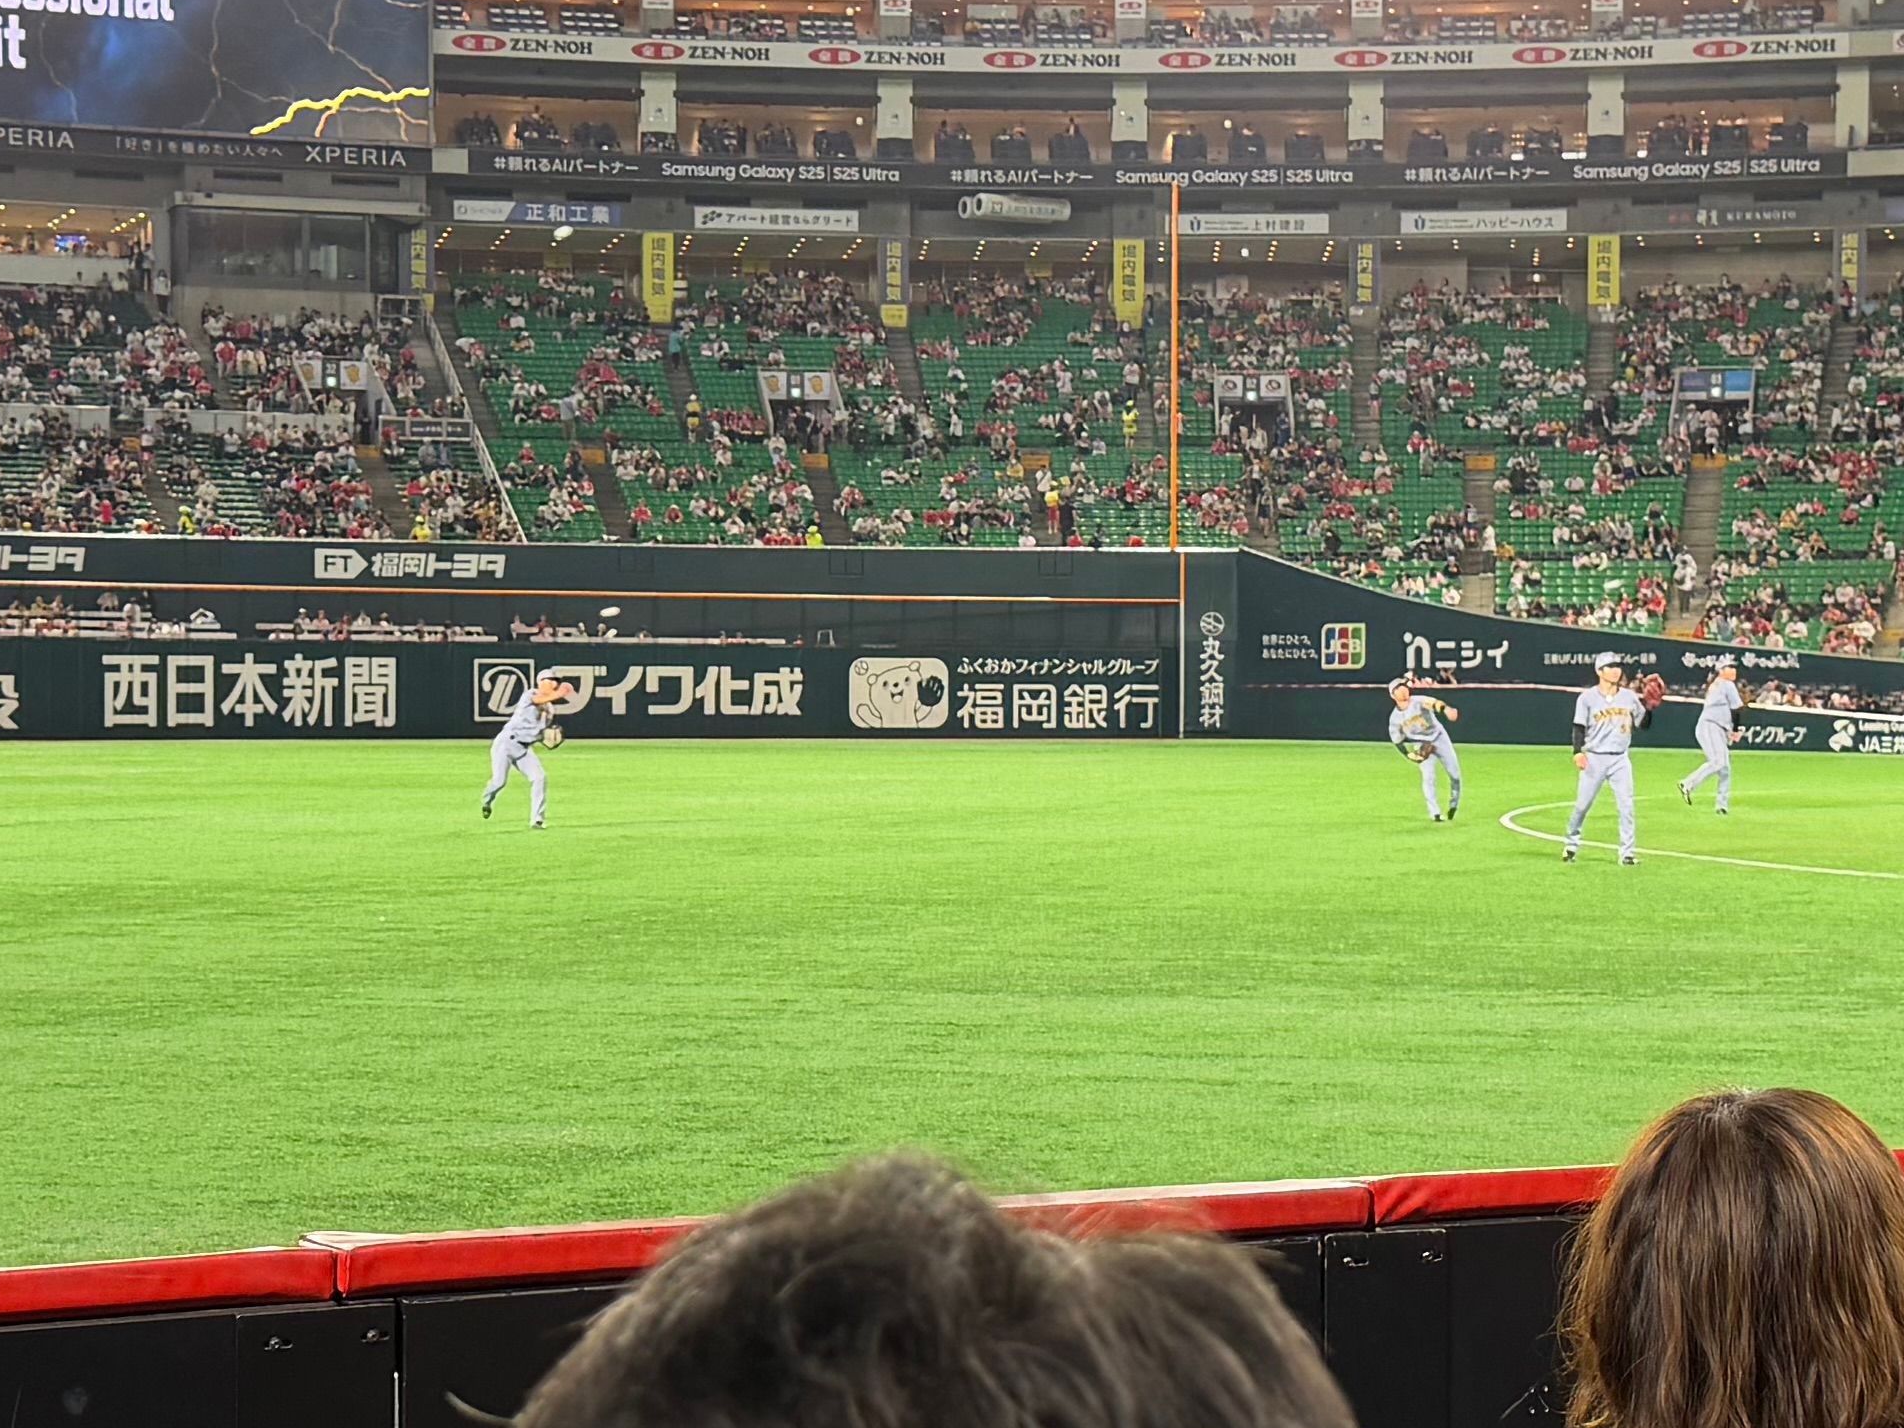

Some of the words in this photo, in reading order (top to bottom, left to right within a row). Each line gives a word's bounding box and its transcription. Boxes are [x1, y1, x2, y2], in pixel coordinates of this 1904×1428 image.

[509, 37, 594, 55] ZEN-NOH
[687, 45, 771, 62] ZEN-NOH
[1568, 44, 1655, 63] ZEN-NOH
[1750, 38, 1838, 58] ZEN-NOH
[863, 49, 946, 66] ZEN-NOH
[1039, 52, 1121, 69] ZEN-NOH
[1214, 51, 1297, 68] ZEN-NOH
[1390, 48, 1475, 67] ZEN-NOH
[304, 145, 407, 168] XPERIA
[662, 162, 737, 182] Samsung
[739, 163, 796, 184] Galaxy
[862, 165, 901, 183] Ultra
[1115, 169, 1189, 187] Samsung
[1192, 168, 1249, 187] Galaxy
[1315, 168, 1353, 184] Ultra
[1572, 162, 1650, 182] Samsung
[1652, 160, 1711, 180] Galaxy
[1780, 156, 1821, 173] Ultra
[323, 554, 355, 573] FT
[371, 552, 507, 580] 福岡トヨタ
[1324, 638, 1362, 654] JCB
[1435, 639, 1510, 669] ニシイ
[956, 656, 1161, 679] ふくおかフィナンシャルグループ
[101, 653, 398, 729] 西日本新聞
[1199, 636, 1225, 730] 丸久鋼材
[955, 682, 1161, 730] 福岡銀行
